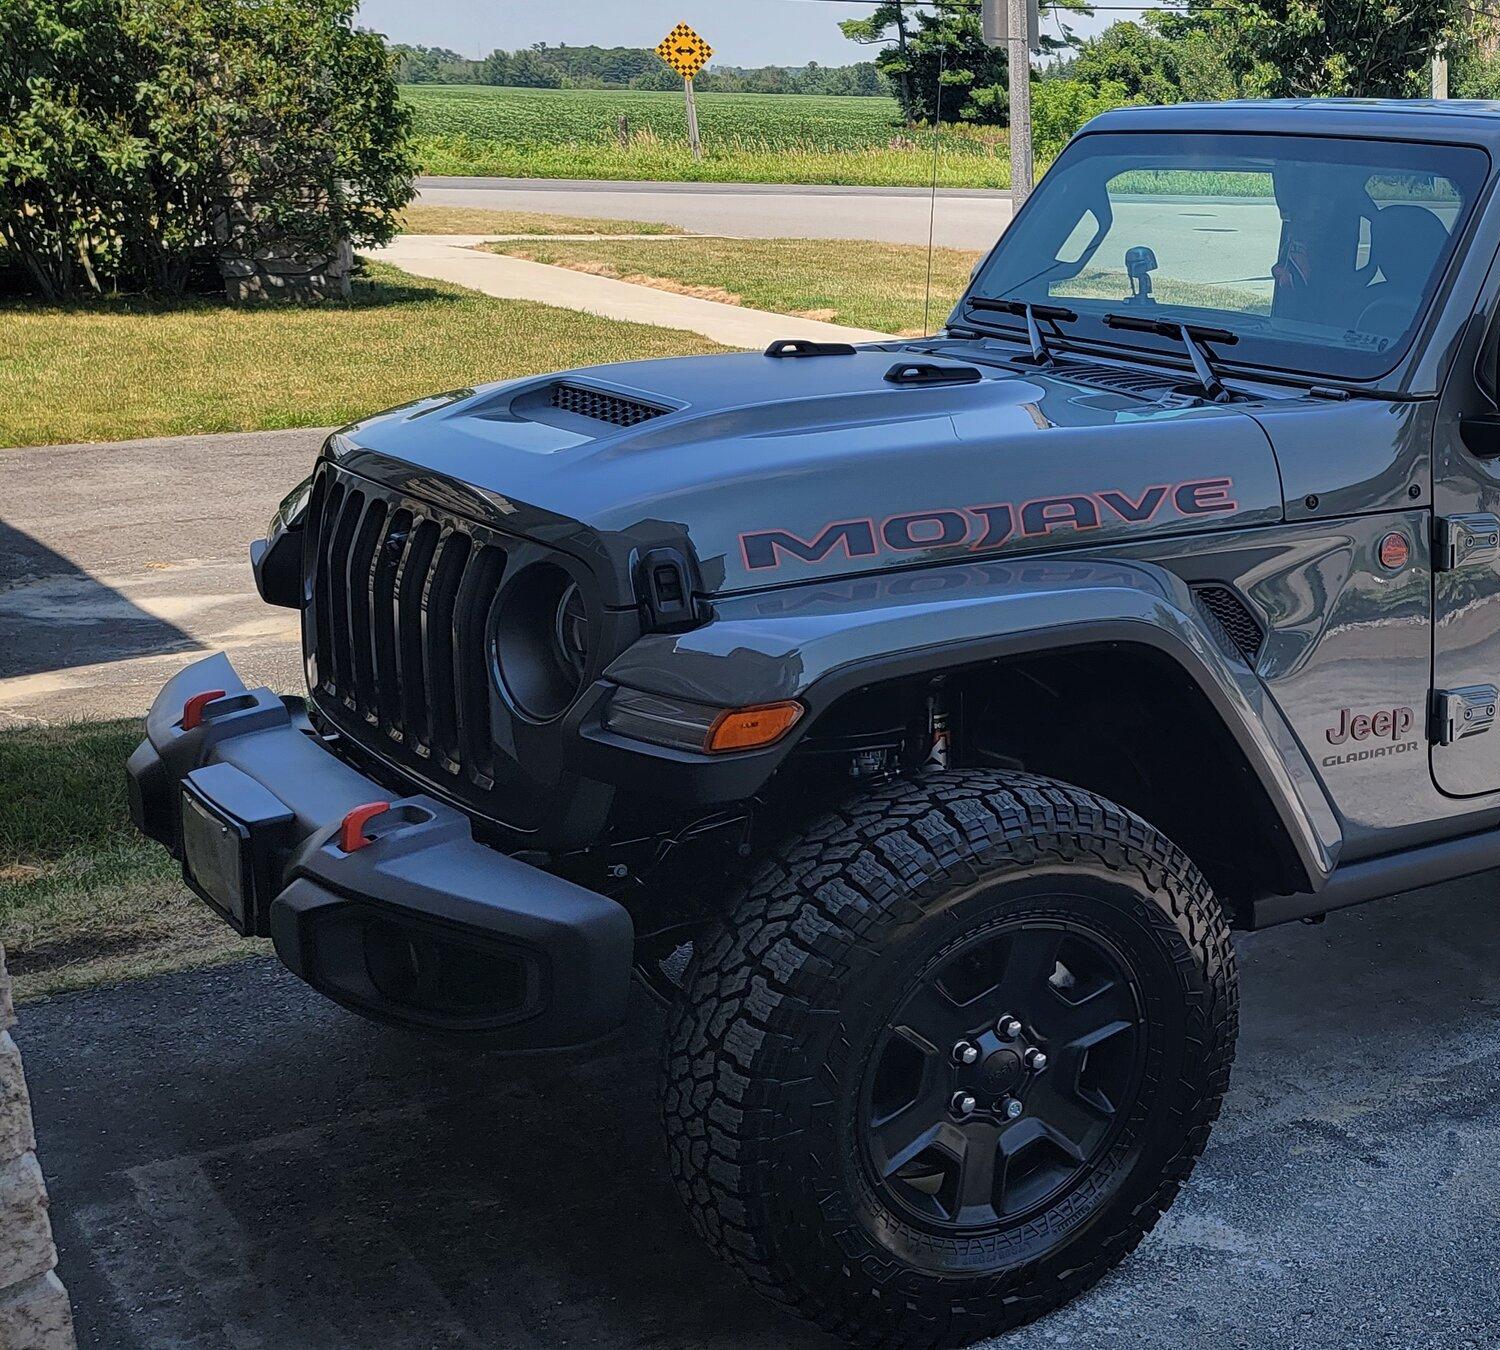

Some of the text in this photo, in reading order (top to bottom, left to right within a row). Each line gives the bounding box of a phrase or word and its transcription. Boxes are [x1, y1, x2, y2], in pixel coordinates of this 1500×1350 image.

[738, 476, 1239, 571] MOJAVE
[1325, 706, 1415, 745] Jeep
[1322, 741, 1419, 767] GLADIATOR
